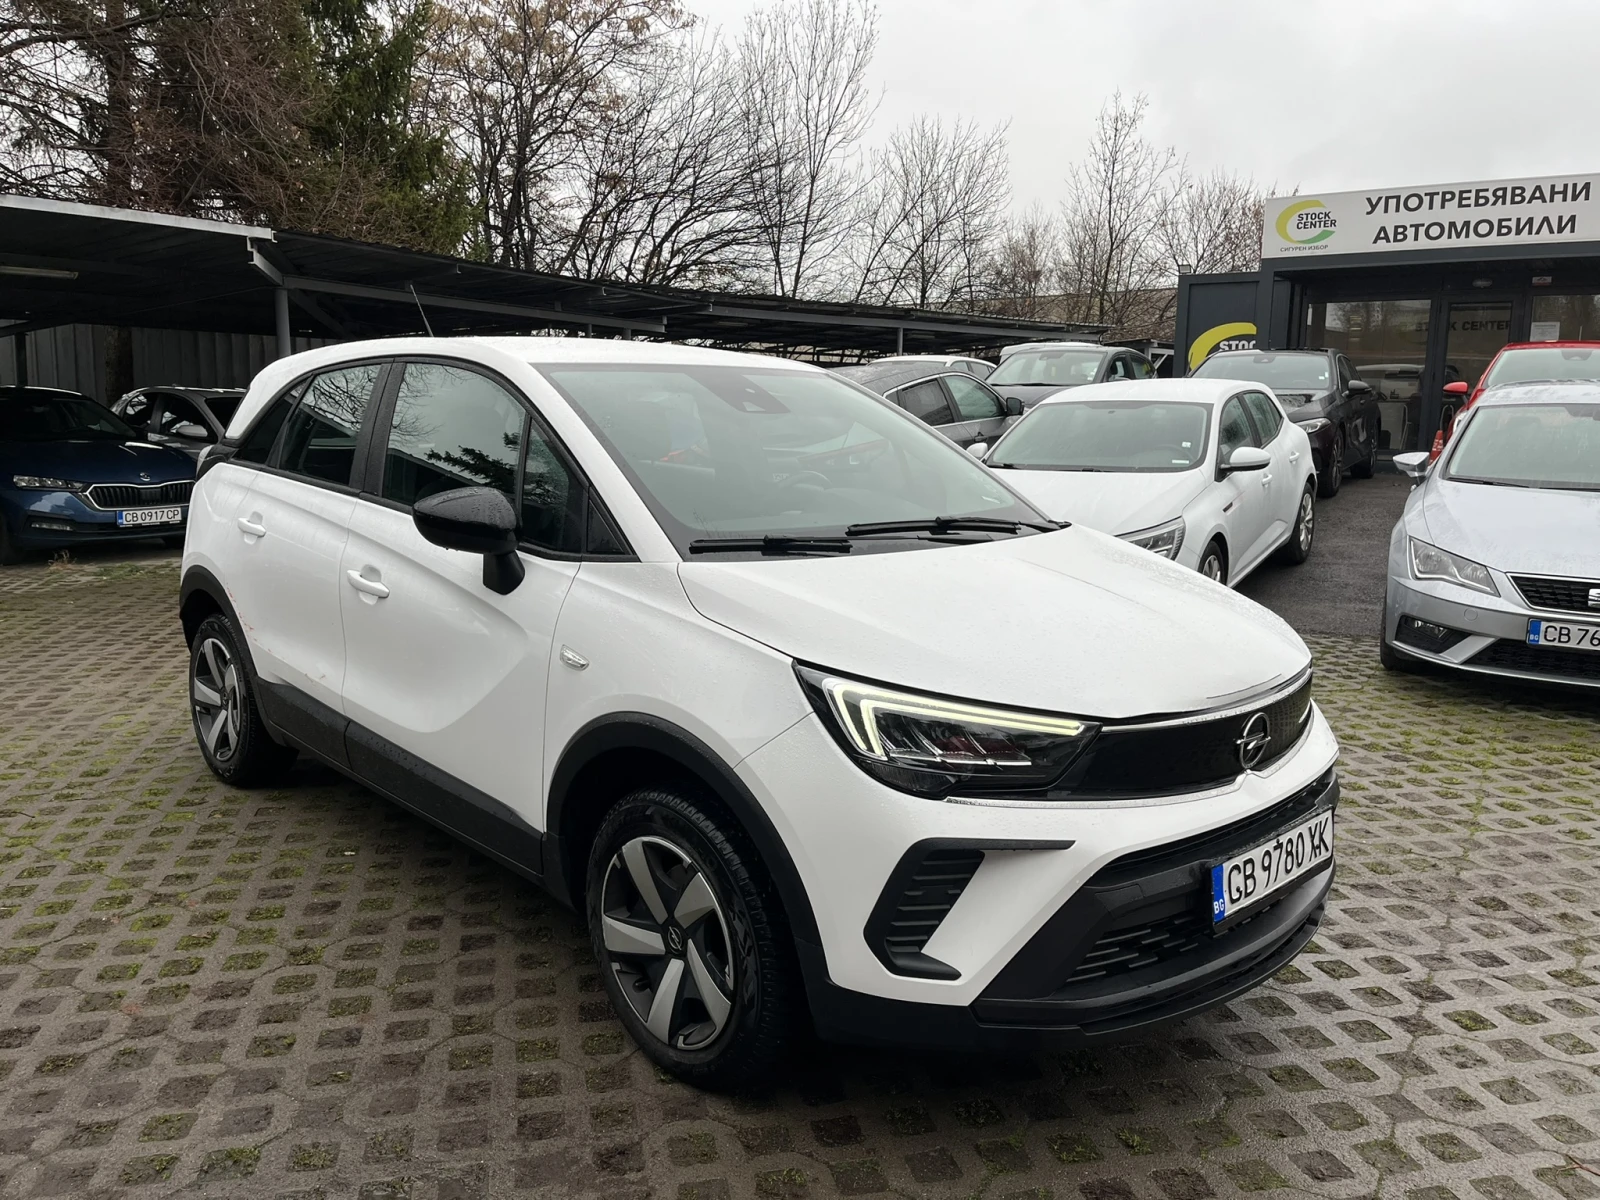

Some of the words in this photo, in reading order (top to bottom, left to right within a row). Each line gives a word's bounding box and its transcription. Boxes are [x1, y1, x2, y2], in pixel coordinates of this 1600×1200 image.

[1365, 181, 1591, 215] УПОТРЕБЯВАНИ
[1296, 219, 1337, 230] CENTER
[1297, 211, 1331, 221] STOCK
[1372, 214, 1577, 244] АВТОМОБИЛИ
[124, 512, 139, 523] CB
[140, 510, 165, 522] 0917
[166, 509, 180, 520] CP
[1543, 624, 1571, 644] CB
[1576, 627, 1600, 647] 76
[1227, 857, 1257, 905] CB
[1261, 831, 1305, 889] 9780
[1308, 816, 1330, 863] XK
[1213, 899, 1225, 915] BG
